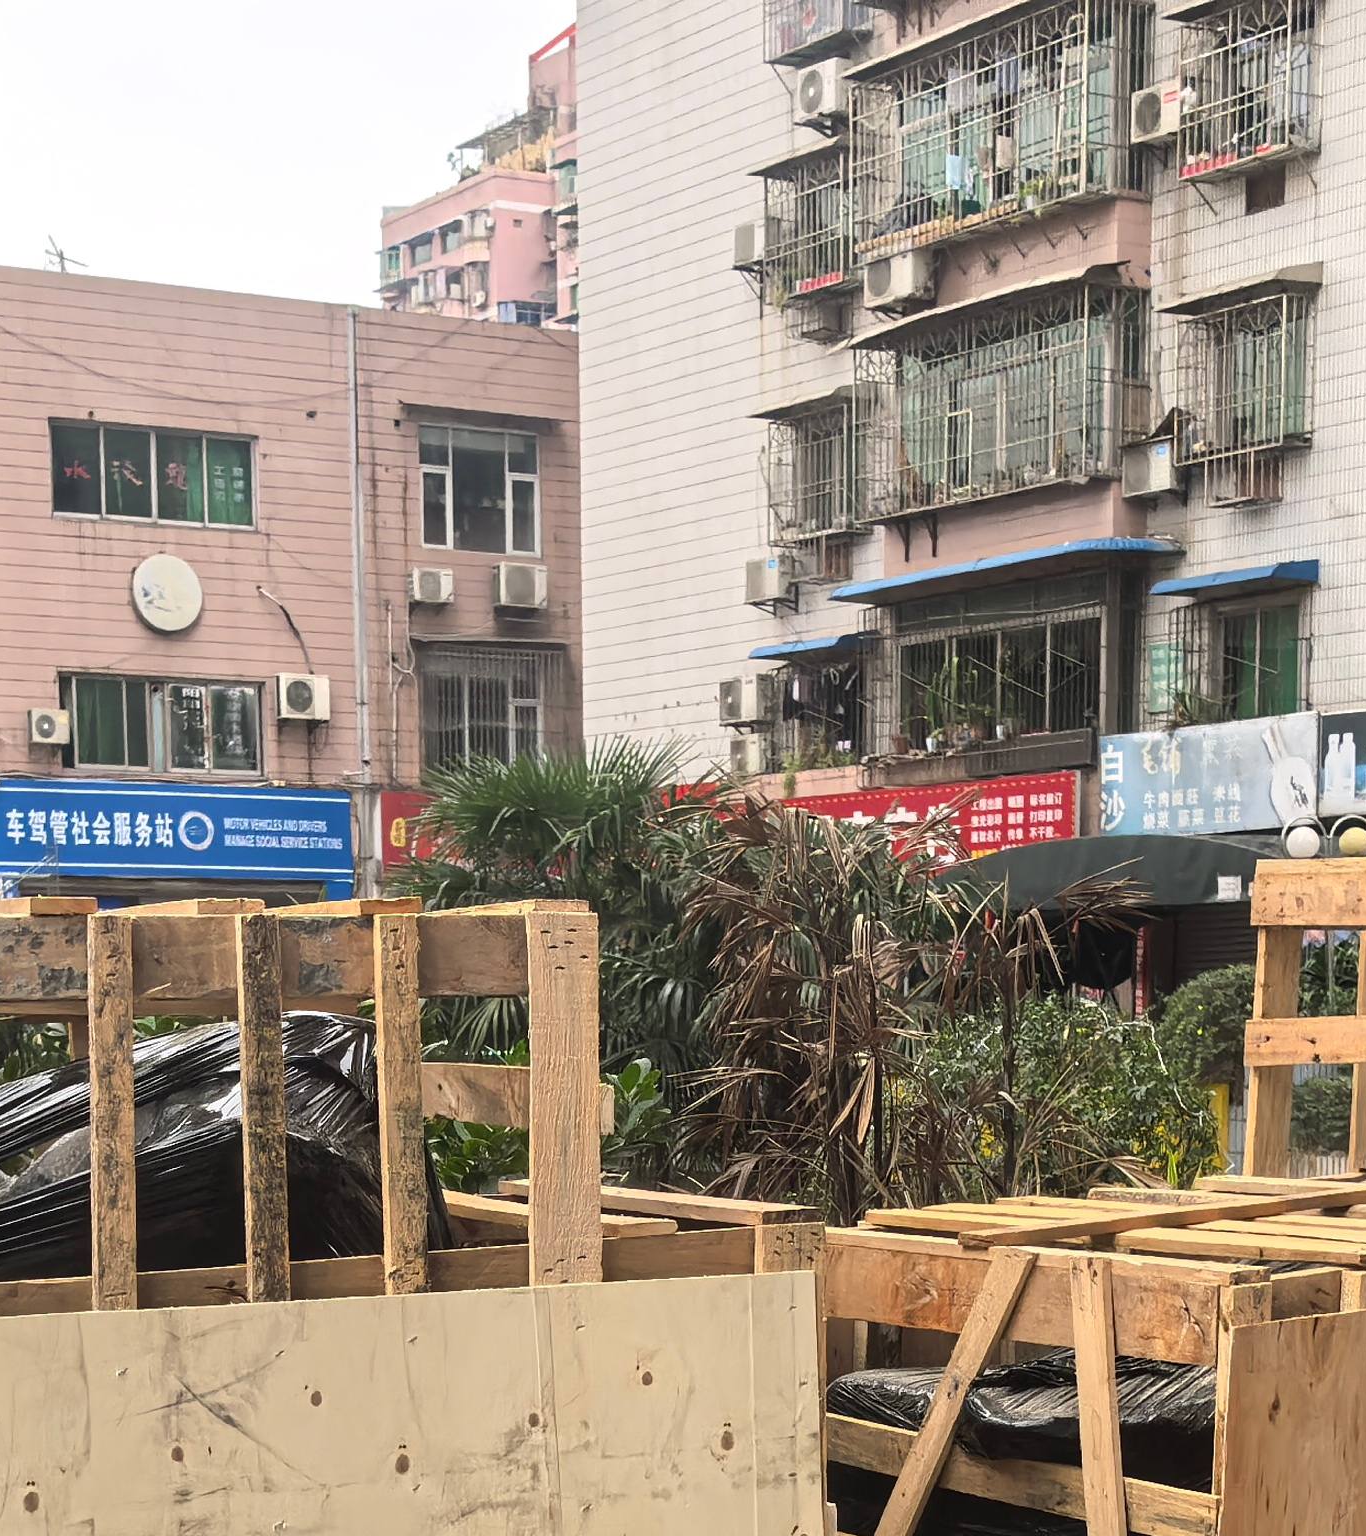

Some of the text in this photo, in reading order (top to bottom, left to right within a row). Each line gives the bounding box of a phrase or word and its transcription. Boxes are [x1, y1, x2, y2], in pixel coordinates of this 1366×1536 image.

[1099, 744, 1127, 832] 白沙
[6, 808, 175, 848] 车驾管社会服务站
